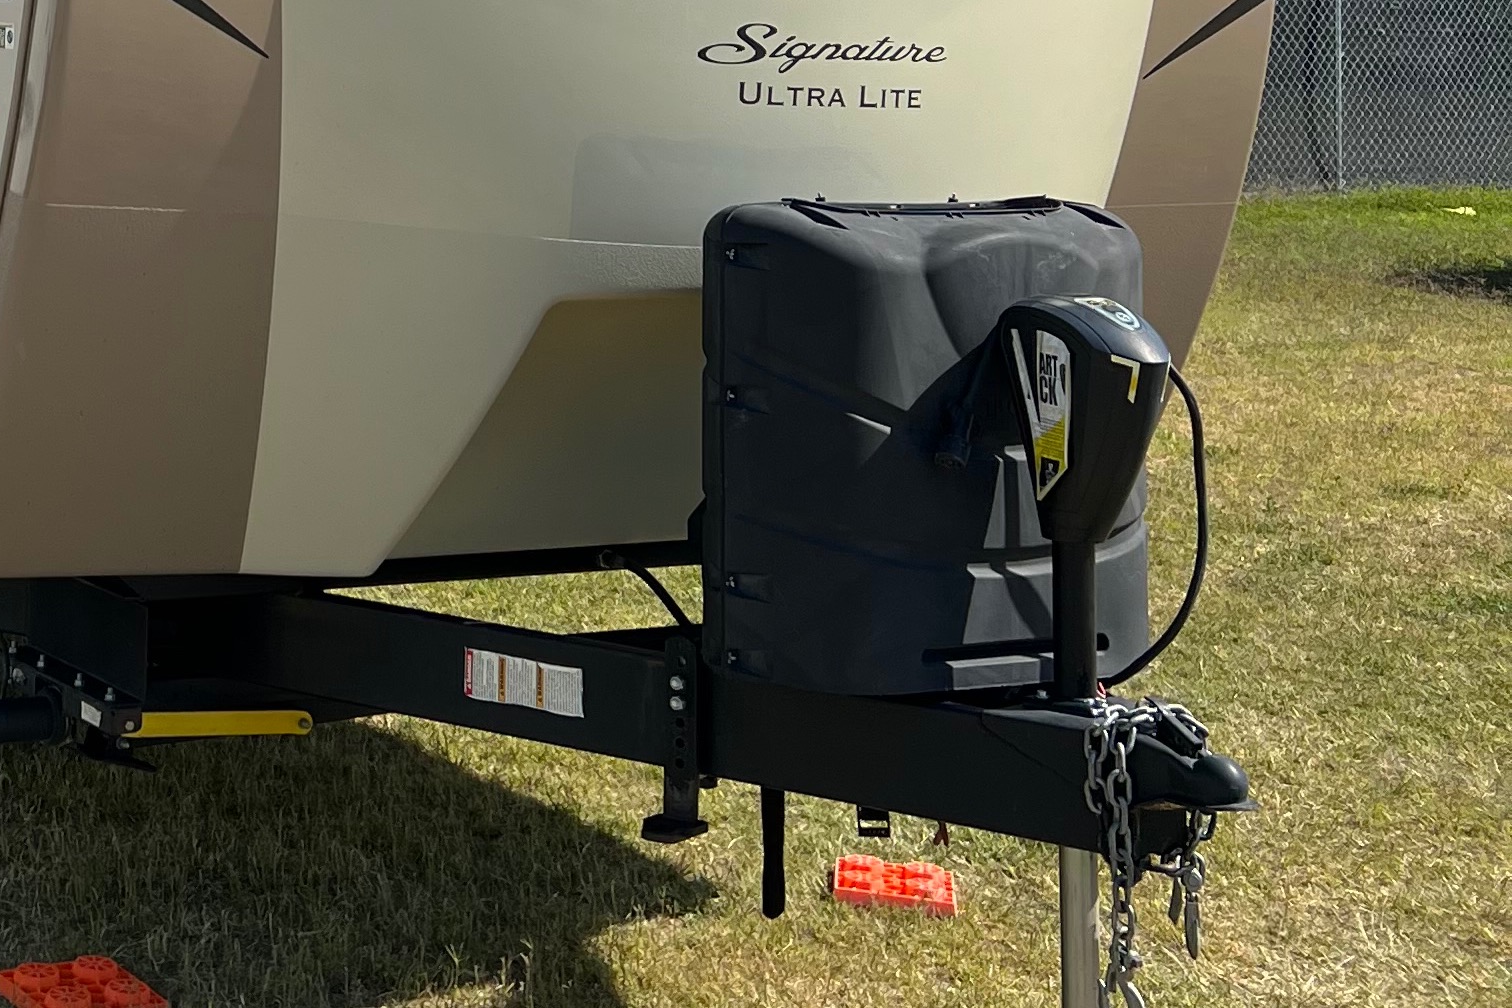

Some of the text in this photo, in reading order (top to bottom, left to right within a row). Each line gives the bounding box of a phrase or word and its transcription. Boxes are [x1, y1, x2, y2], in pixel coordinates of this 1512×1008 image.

[696, 22, 948, 74] Signature
[738, 80, 922, 109] ULTRA LITE
